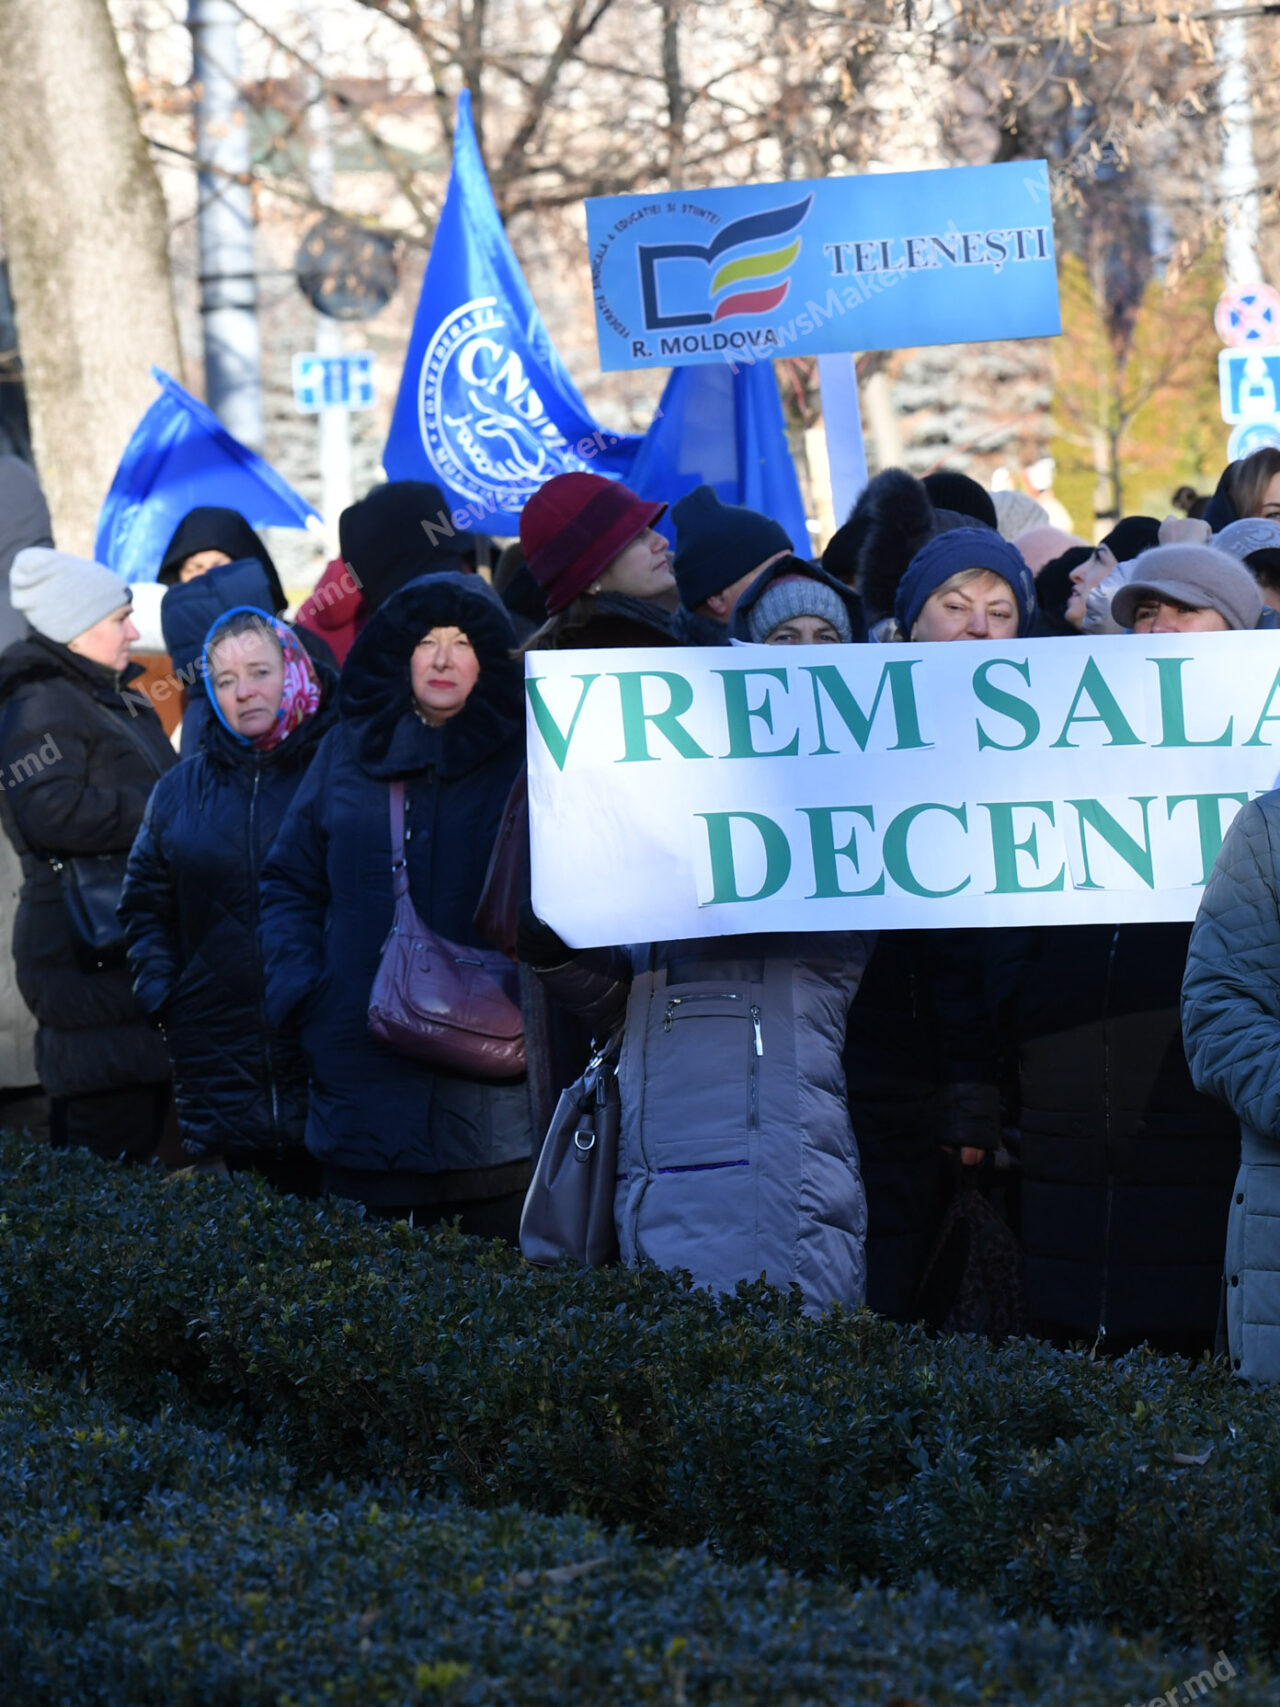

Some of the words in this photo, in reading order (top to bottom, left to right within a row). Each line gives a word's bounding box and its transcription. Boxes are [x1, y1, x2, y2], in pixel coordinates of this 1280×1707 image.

[632, 341, 652, 357] R.
[660, 329, 778, 355] MOLDOVA
[525, 660, 935, 772] VREM
[693, 790, 1272, 906] DECENT
